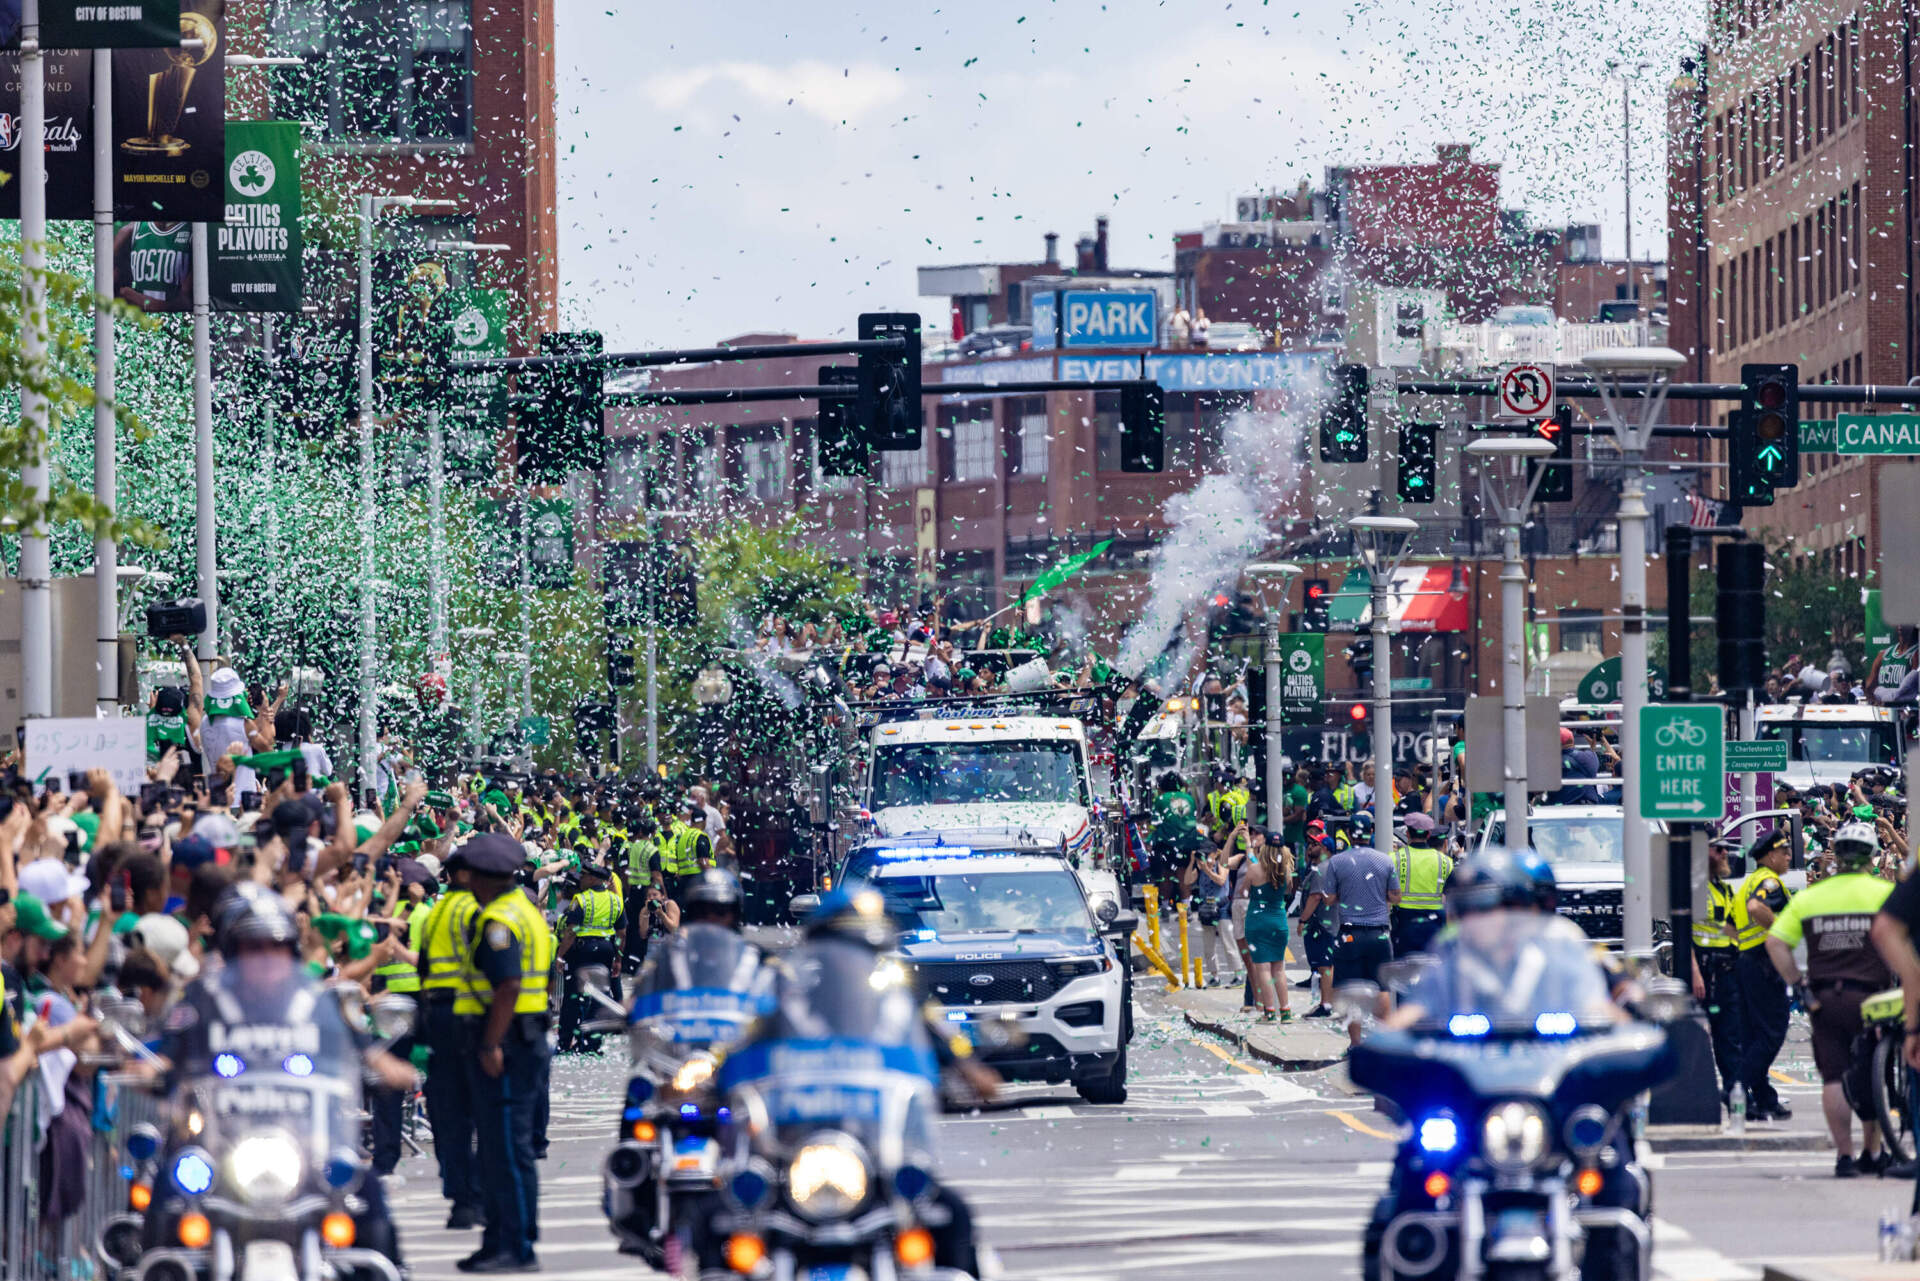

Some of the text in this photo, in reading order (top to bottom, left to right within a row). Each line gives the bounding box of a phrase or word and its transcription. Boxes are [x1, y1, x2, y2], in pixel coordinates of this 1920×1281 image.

[75, 6, 142, 21] CITY OF BOSTON
[50, 64, 65, 75] BE
[233, 153, 272, 172] CELTICS
[123, 174, 186, 184] MAYOR MICHELLE WU
[225, 203, 281, 227] CELTICS
[218, 227, 288, 251] PLAYOFFS
[231, 283, 277, 293] CITY OF BOSTON
[1069, 302, 1149, 336] PARK
[1063, 358, 1163, 383] EVENT
[1845, 423, 1920, 445] CANAL
[1283, 685, 1318, 698] PLAYOFFS
[1656, 754, 1706, 771] ENTER
[1660, 778, 1701, 795] HERE
[1812, 914, 1871, 934] Boston
[955, 952, 1002, 961] POLICE
